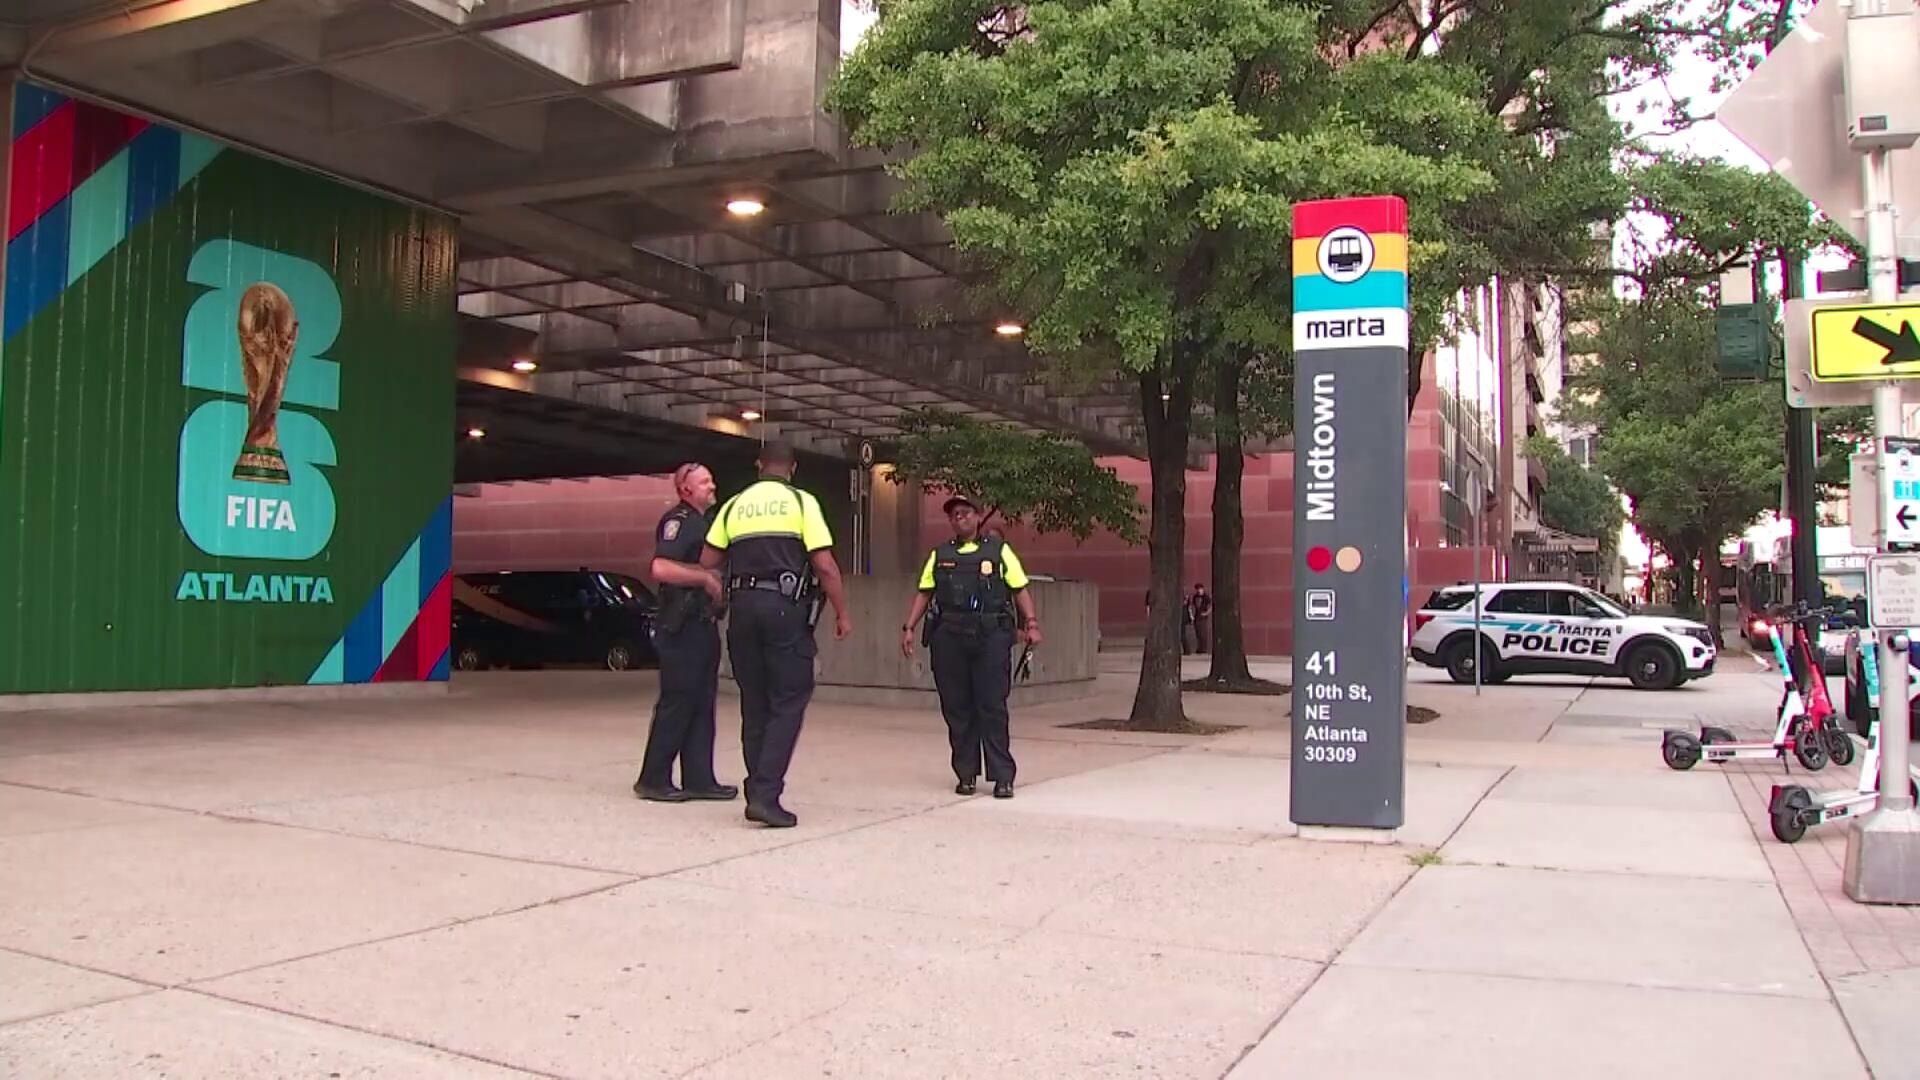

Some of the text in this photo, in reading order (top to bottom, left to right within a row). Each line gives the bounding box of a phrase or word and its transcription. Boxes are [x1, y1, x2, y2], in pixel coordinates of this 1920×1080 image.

[1306, 316, 1386, 340] marta
[1306, 373, 1336, 521] Midtown
[226, 495, 297, 532] FIFA
[737, 500, 790, 520] POLICE
[176, 571, 335, 604] ATLANTA
[1557, 624, 1612, 637] MARTA
[1502, 633, 1611, 656] POLICE
[1304, 650, 1337, 675] 41
[1304, 683, 1372, 703] 10th St,
[1304, 704, 1331, 720] NE
[1303, 725, 1368, 742] Atlanta
[1304, 745, 1357, 762] 30309
